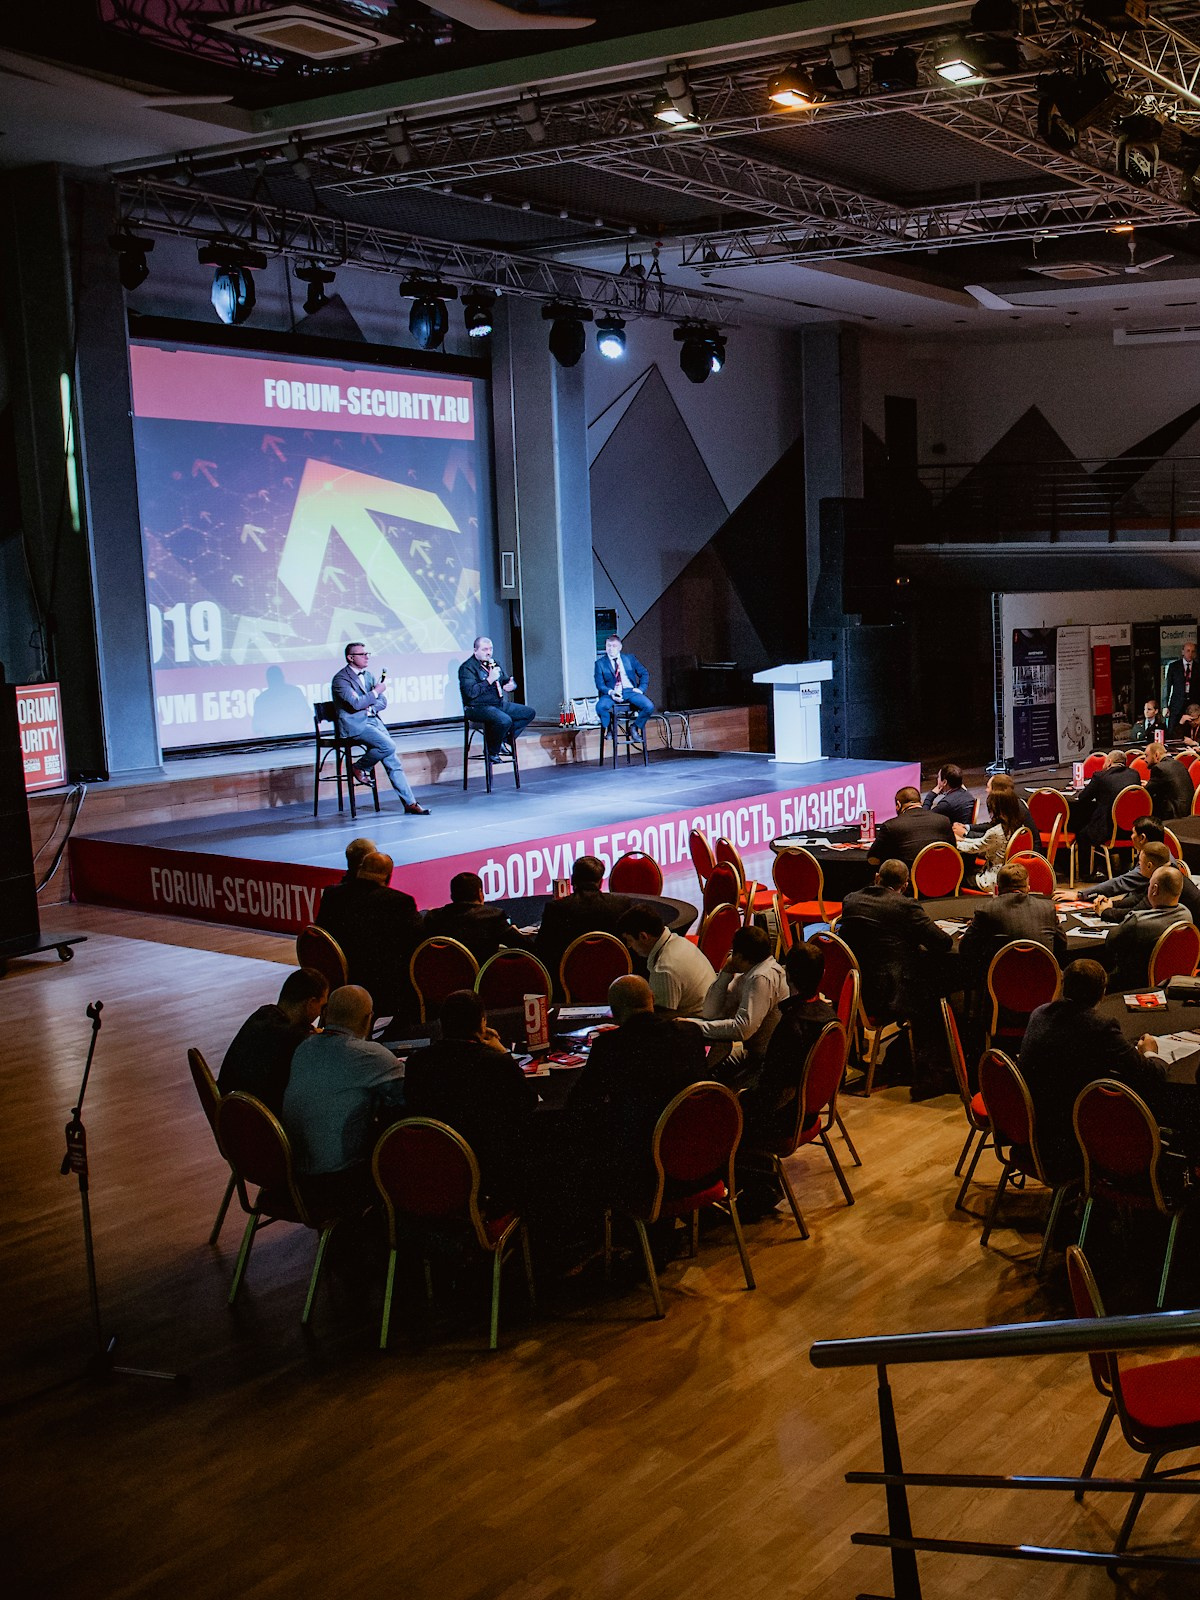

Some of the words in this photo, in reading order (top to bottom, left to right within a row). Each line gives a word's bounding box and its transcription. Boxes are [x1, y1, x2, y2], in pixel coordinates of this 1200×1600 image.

[264, 379, 469, 424] FORUM-SECURITY.RU
[17, 696, 57, 725] ORUM
[157, 693, 198, 726] УМ
[20, 726, 57, 754] URITY
[860, 811, 870, 831] 9
[478, 841, 586, 901] ФОРУМ
[781, 783, 867, 834] БИЗНЕСА
[151, 867, 325, 923] FORUM-SECURITY
[525, 999, 540, 1033] 9
